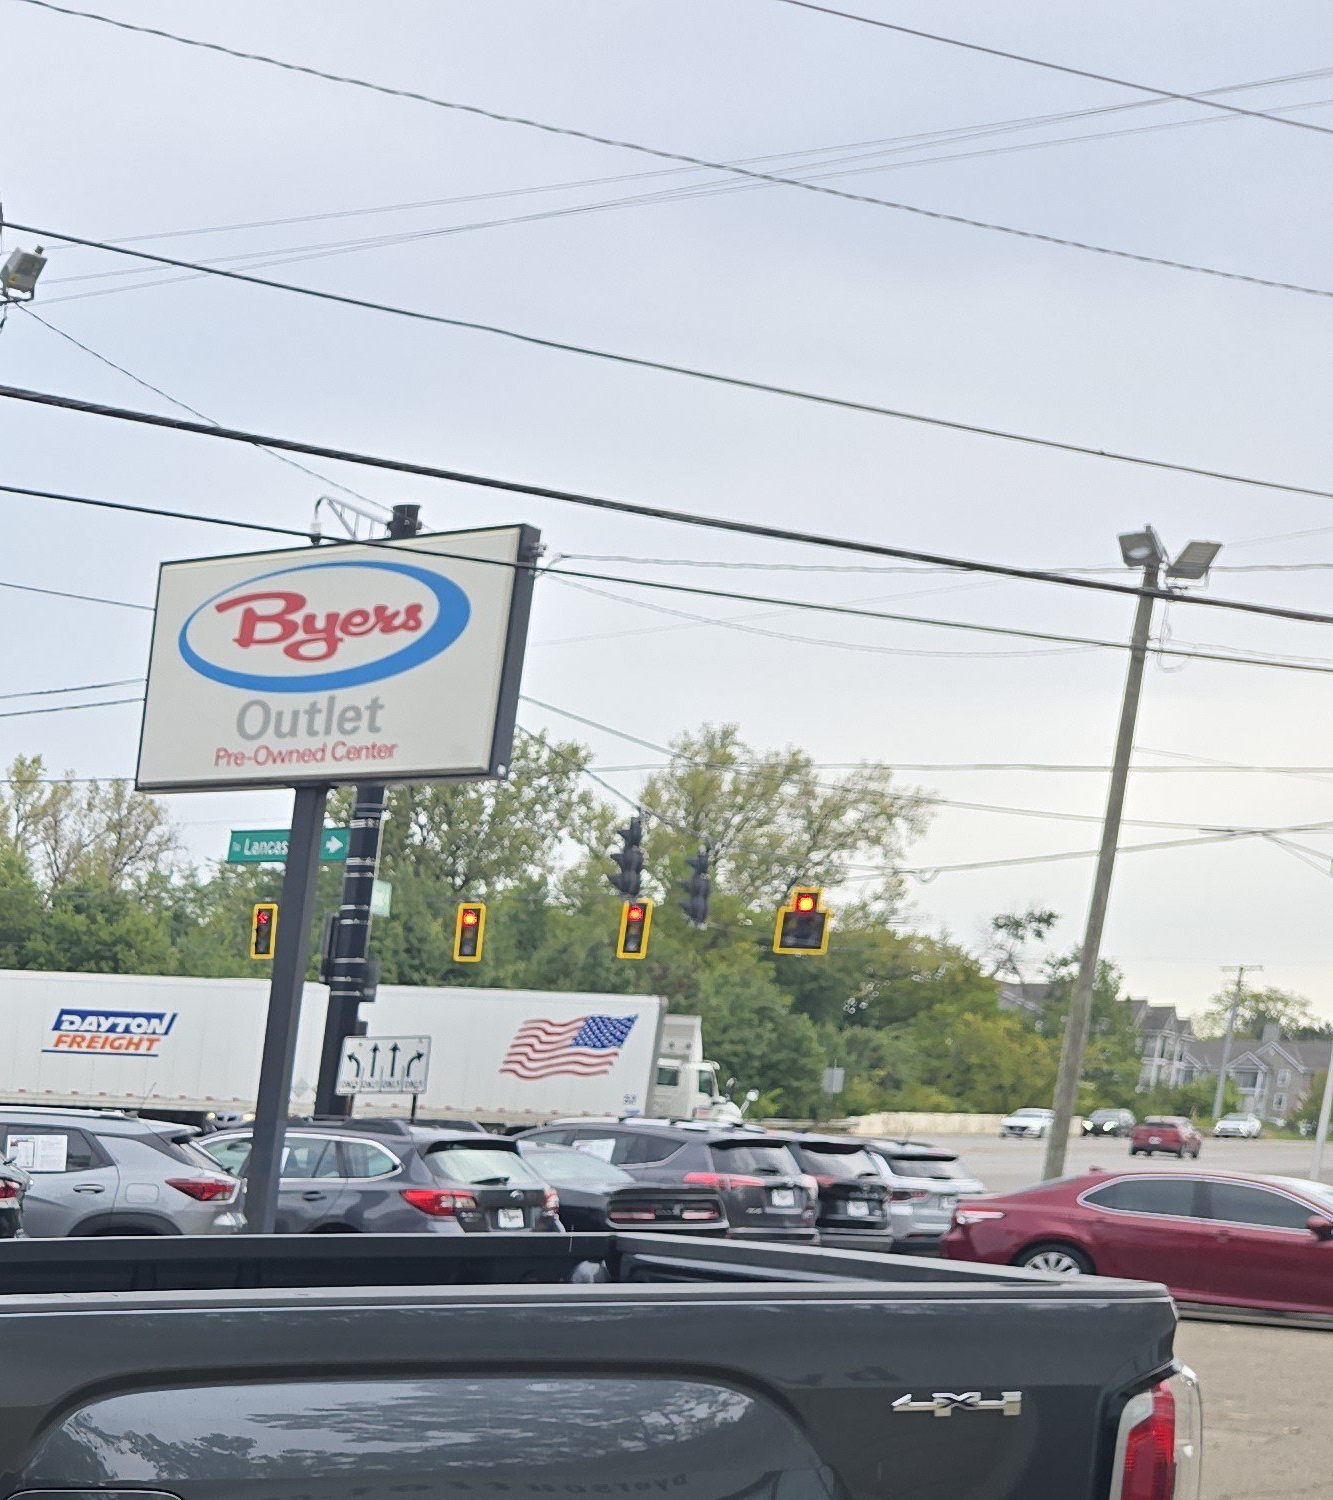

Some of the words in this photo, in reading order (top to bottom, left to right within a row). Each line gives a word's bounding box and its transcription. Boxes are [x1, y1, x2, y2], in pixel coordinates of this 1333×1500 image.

[215, 590, 423, 663] Byers
[236, 694, 385, 741] Outlet
[214, 742, 327, 768] Pre-Owned
[331, 740, 398, 763] Center
[243, 838, 289, 856] Lancas
[59, 1013, 169, 1034] DAYTON
[53, 1033, 161, 1052] FREIGHT
